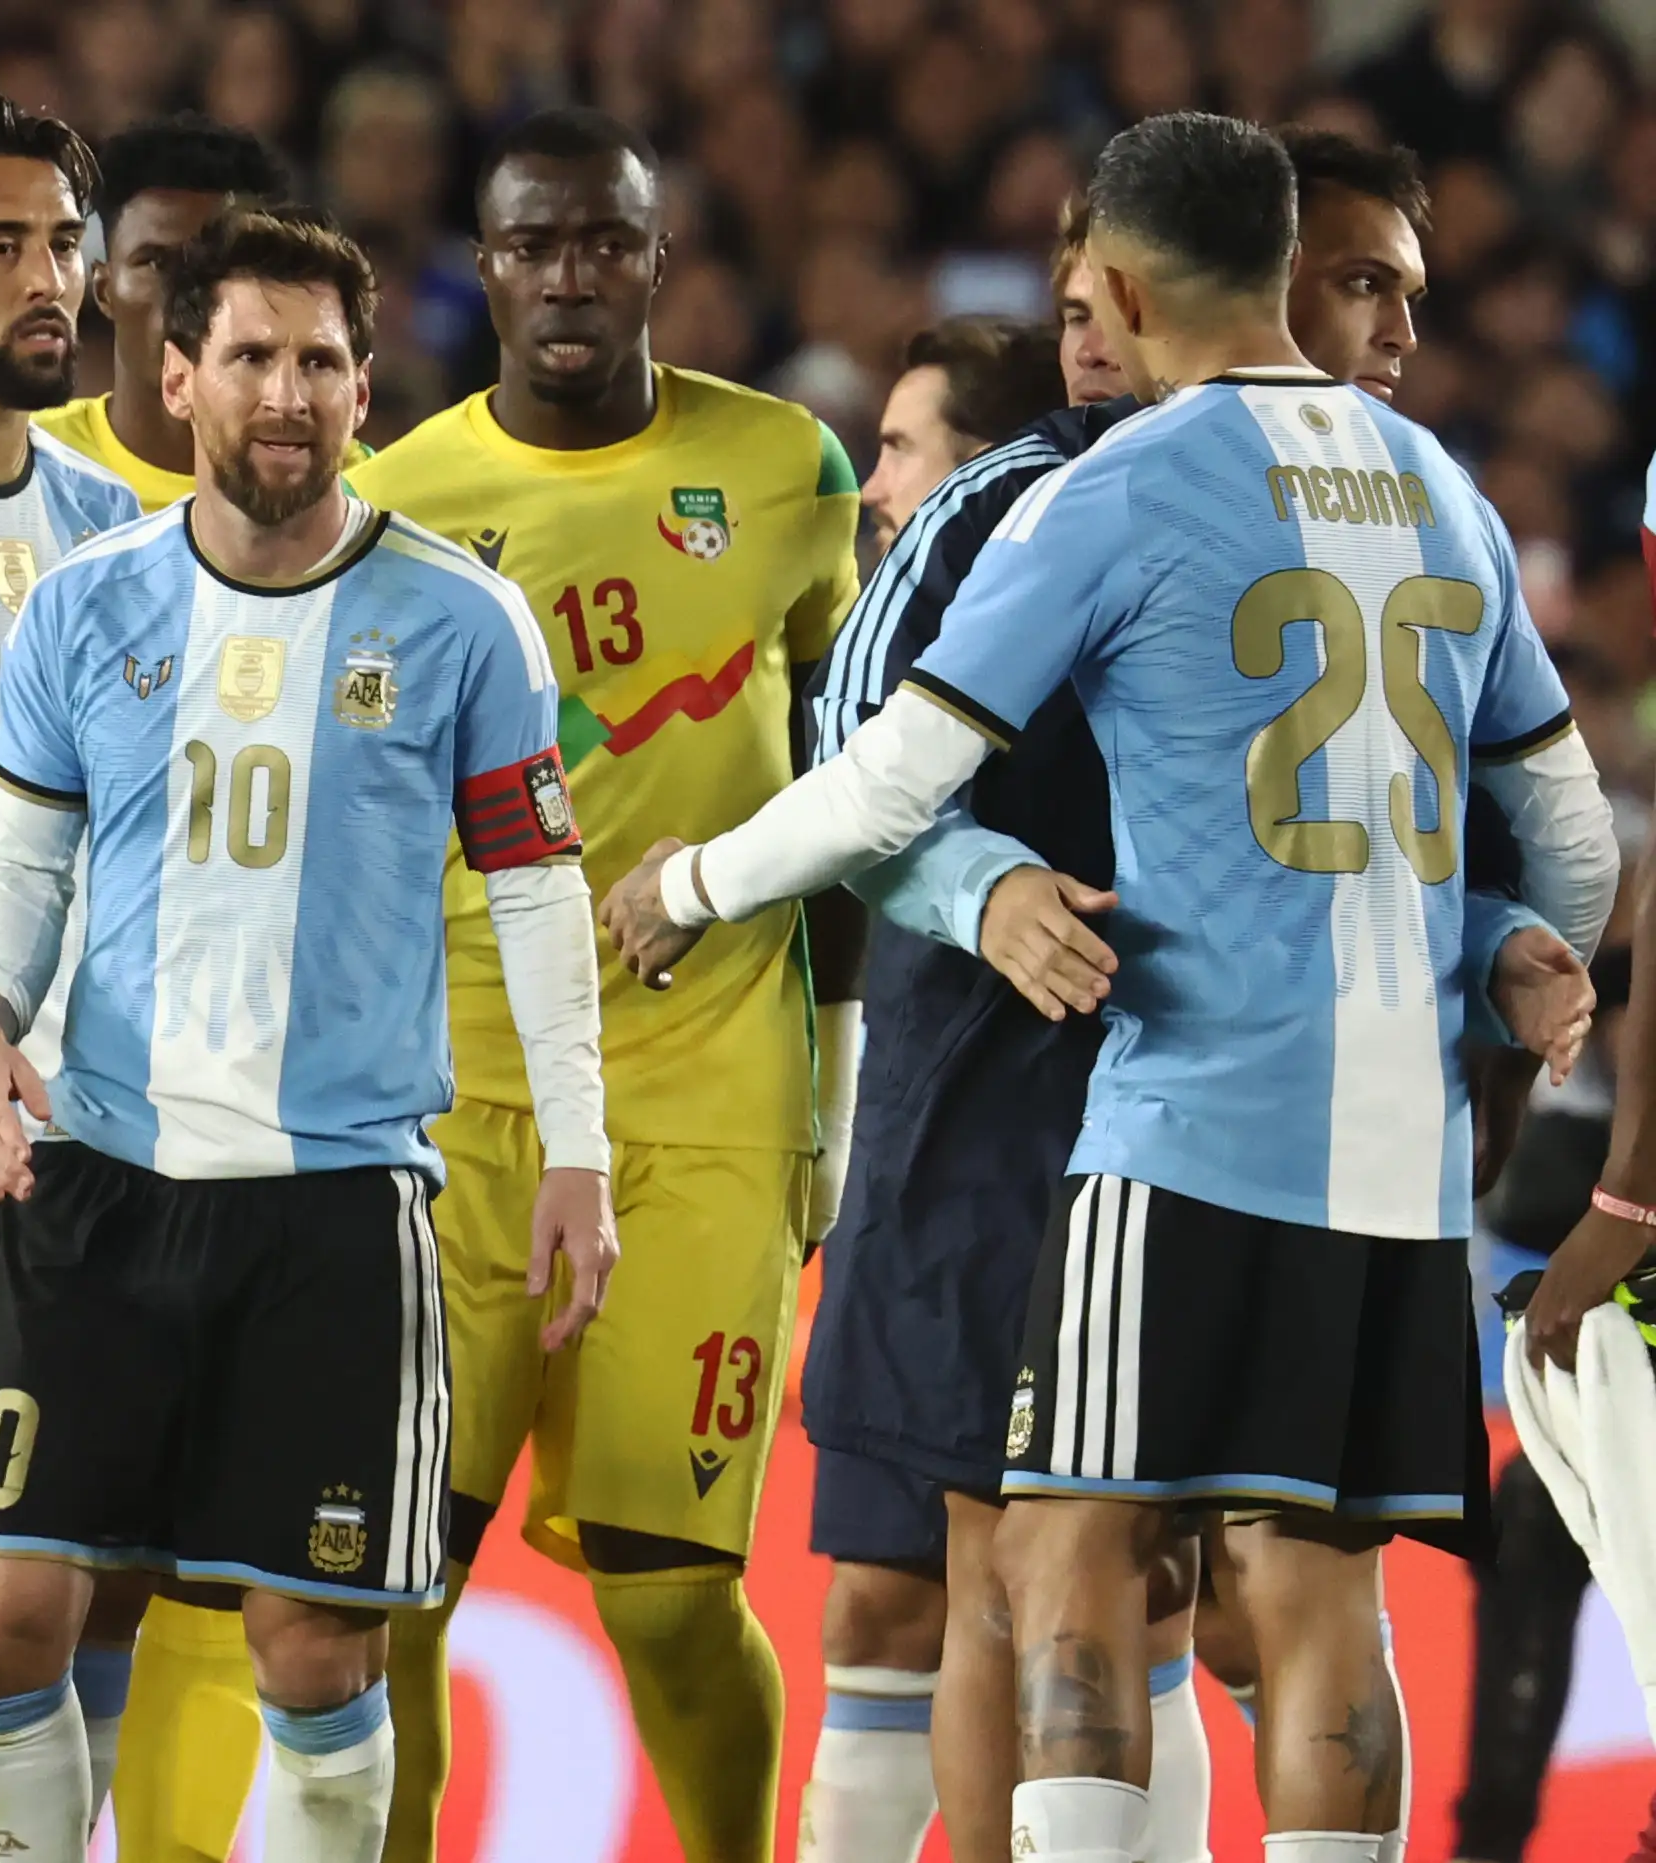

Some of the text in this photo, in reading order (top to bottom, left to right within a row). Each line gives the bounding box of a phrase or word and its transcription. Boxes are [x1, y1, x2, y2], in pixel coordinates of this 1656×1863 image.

[1265, 464, 1437, 529] MEDINA
[553, 577, 644, 674] 13
[346, 671, 383, 708] AFA
[1231, 567, 1484, 885] 25
[185, 739, 291, 869] 10
[690, 1331, 762, 1440] 13
